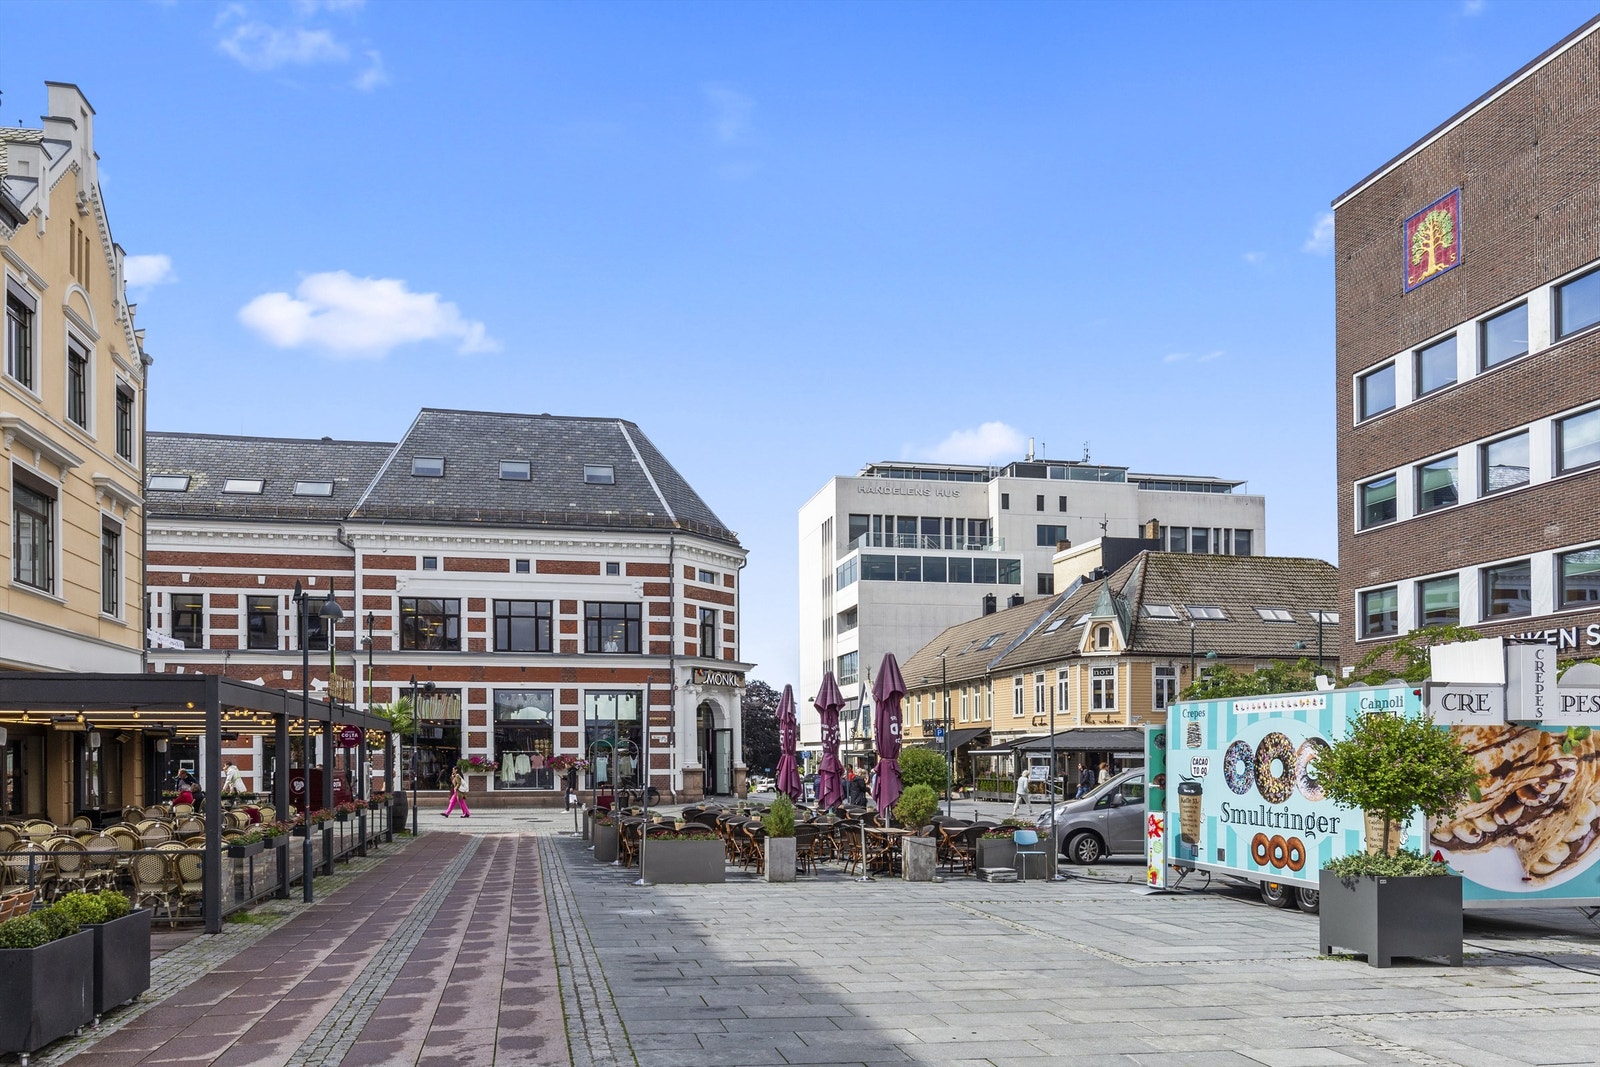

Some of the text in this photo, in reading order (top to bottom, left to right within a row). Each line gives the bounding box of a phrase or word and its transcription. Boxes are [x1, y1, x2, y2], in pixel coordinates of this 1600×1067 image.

[858, 486, 960, 498] HANDELENS HUS
[1510, 626, 1577, 648] EN
[703, 672, 739, 686] MONKI
[1534, 649, 1545, 718] CREPES
[1360, 695, 1404, 710] Cannoli
[1441, 693, 1491, 713] CRE
[1560, 695, 1600, 713] PES
[1182, 708, 1206, 719] Crepes
[1192, 757, 1209, 766] CACAO
[1193, 766, 1200, 775] TO
[1220, 801, 1341, 839] Smultringer
